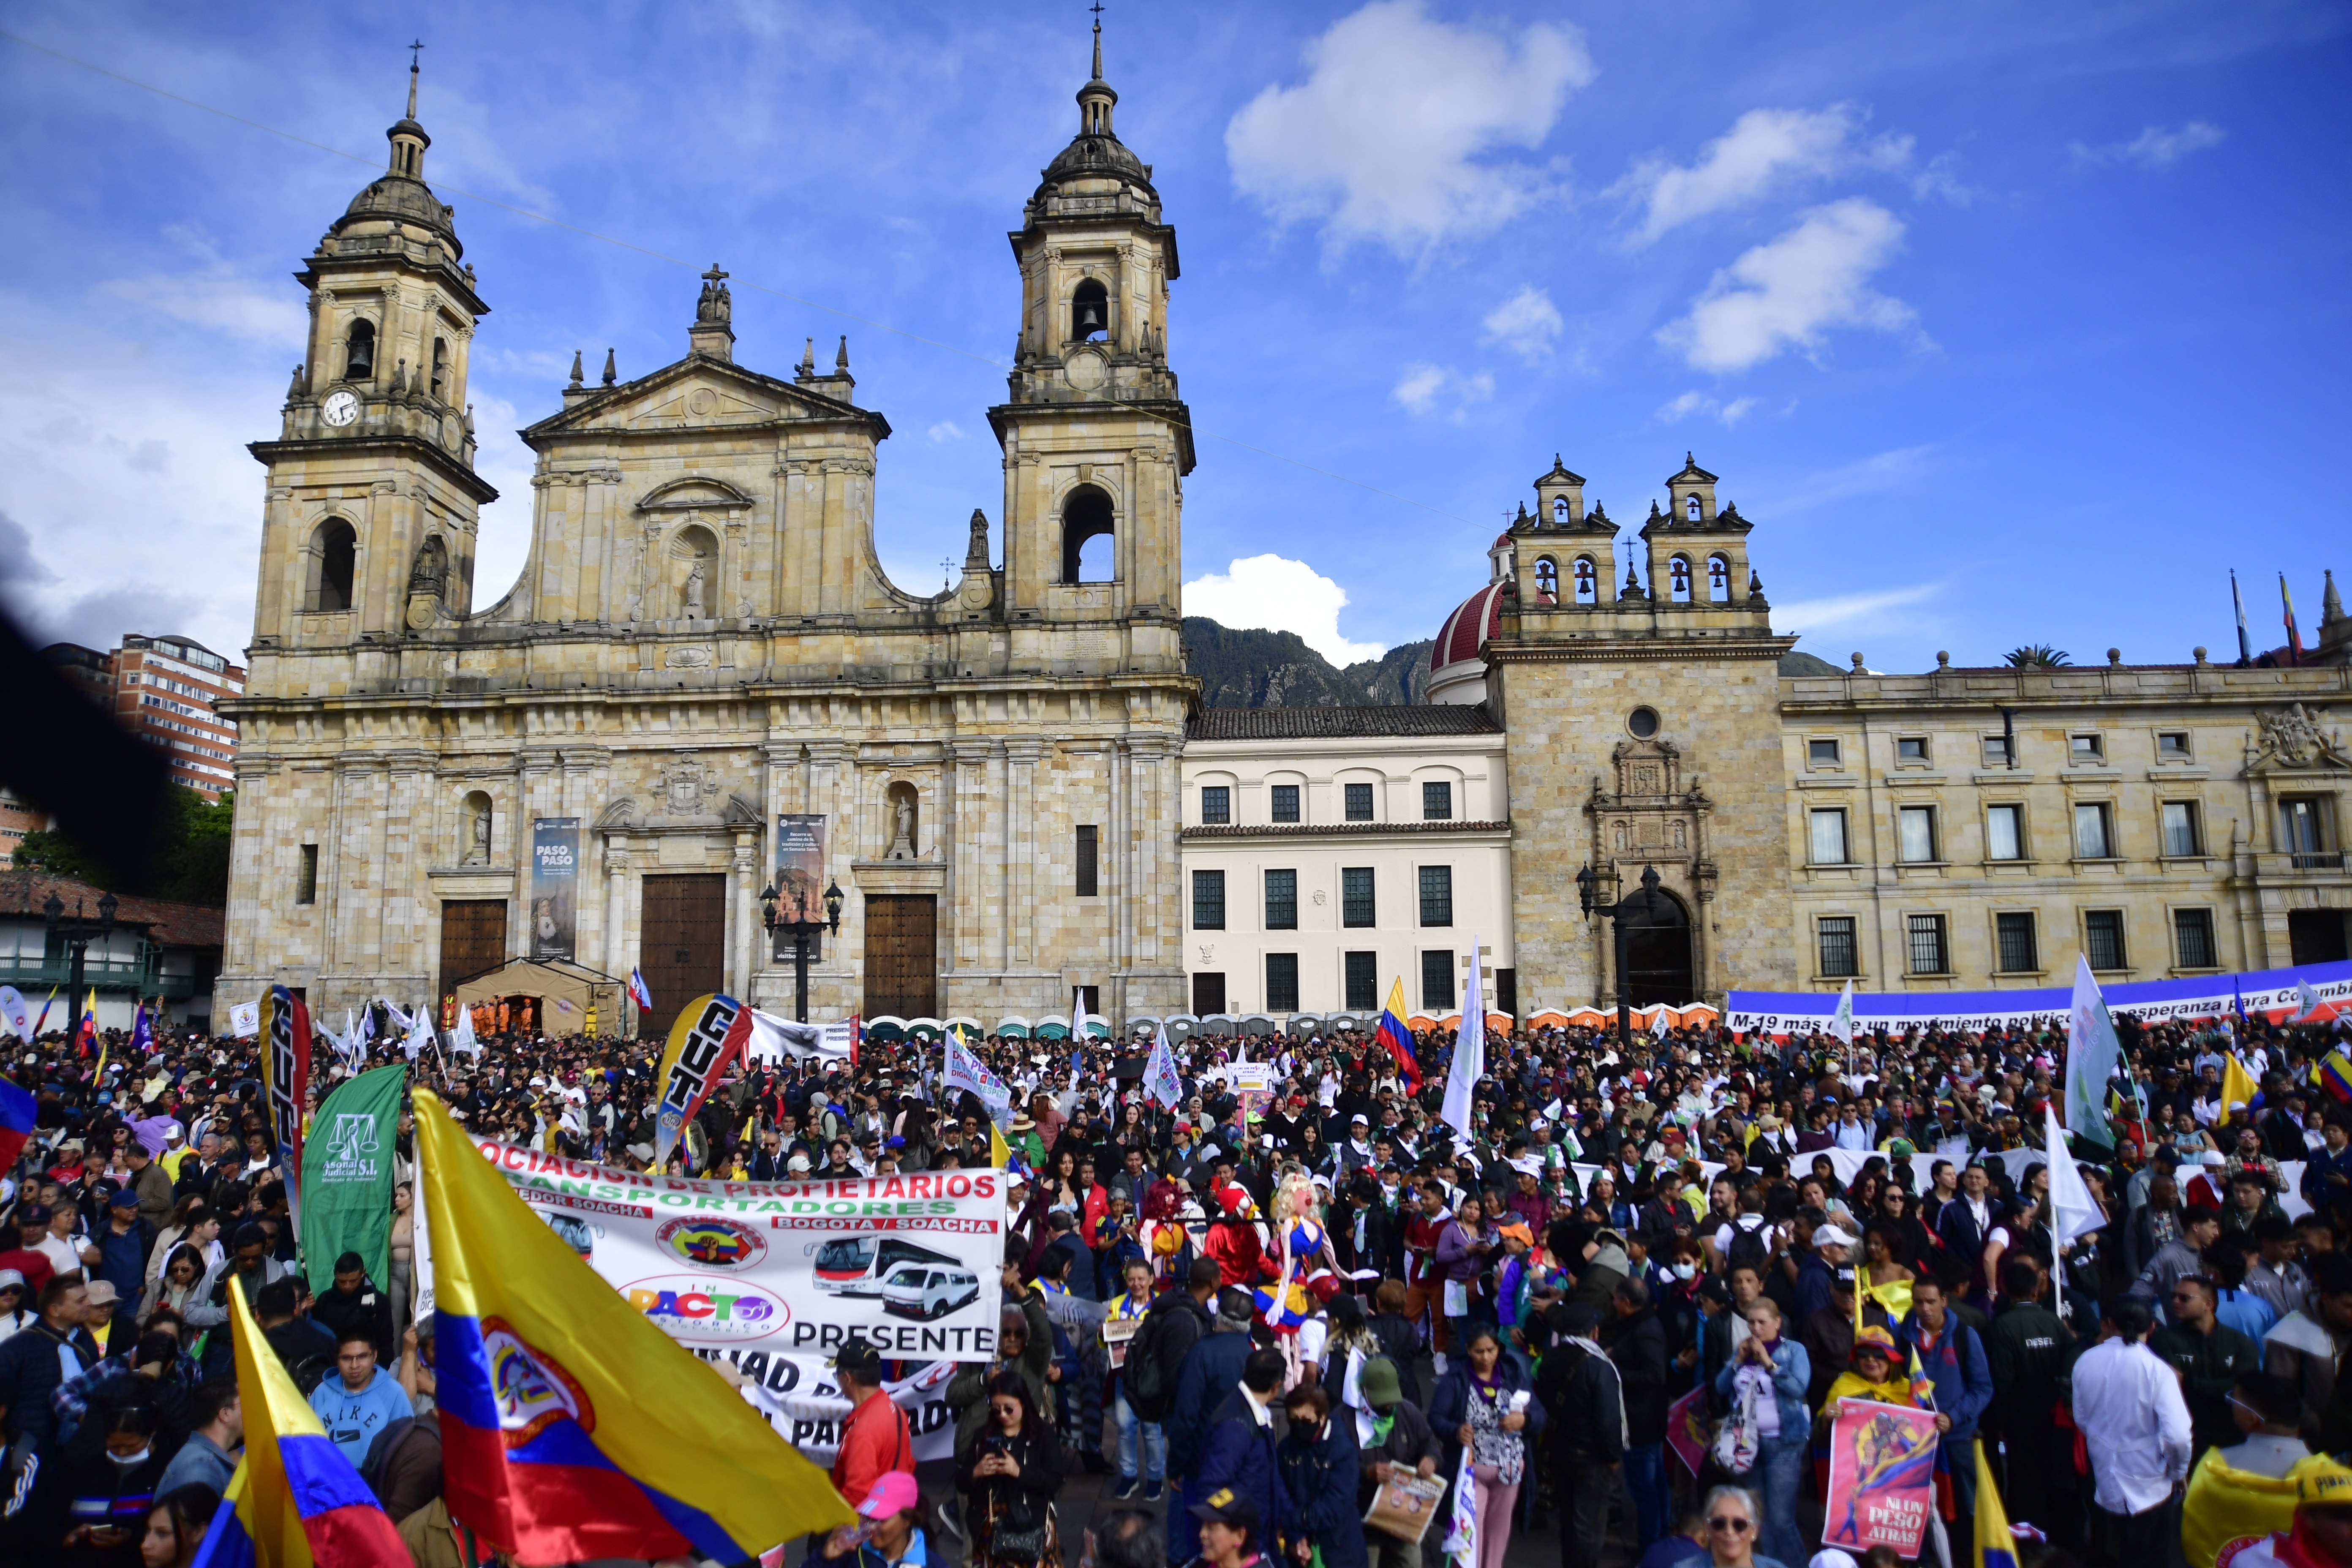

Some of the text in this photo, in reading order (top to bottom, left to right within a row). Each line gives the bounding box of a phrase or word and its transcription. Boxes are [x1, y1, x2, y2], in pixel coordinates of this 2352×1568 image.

[536, 845, 568, 855] PASO
[542, 855, 573, 865] PASO
[1734, 1015, 1778, 1029] M-19
[1783, 1015, 1821, 1030] más
[1867, 1018, 1889, 1032] un
[667, 1001, 737, 1111] CUT
[952, 1069, 972, 1083] DIGNA
[322, 1168, 356, 1176] Judicial
[323, 1160, 357, 1169] Asonal
[359, 1159, 377, 1176] S.I.
[667, 1179, 712, 1194] DE
[723, 1174, 995, 1198] PROPIETARIOS
[572, 1198, 646, 1217] SOACHA
[777, 1217, 878, 1230] BOGOTA
[903, 1218, 992, 1233] SOACHA
[422, 1288, 434, 1300] POR
[322, 1405, 378, 1429] NIKE
[1886, 1496, 1923, 1514] NI UN
[1868, 1506, 1921, 1529] PESO
